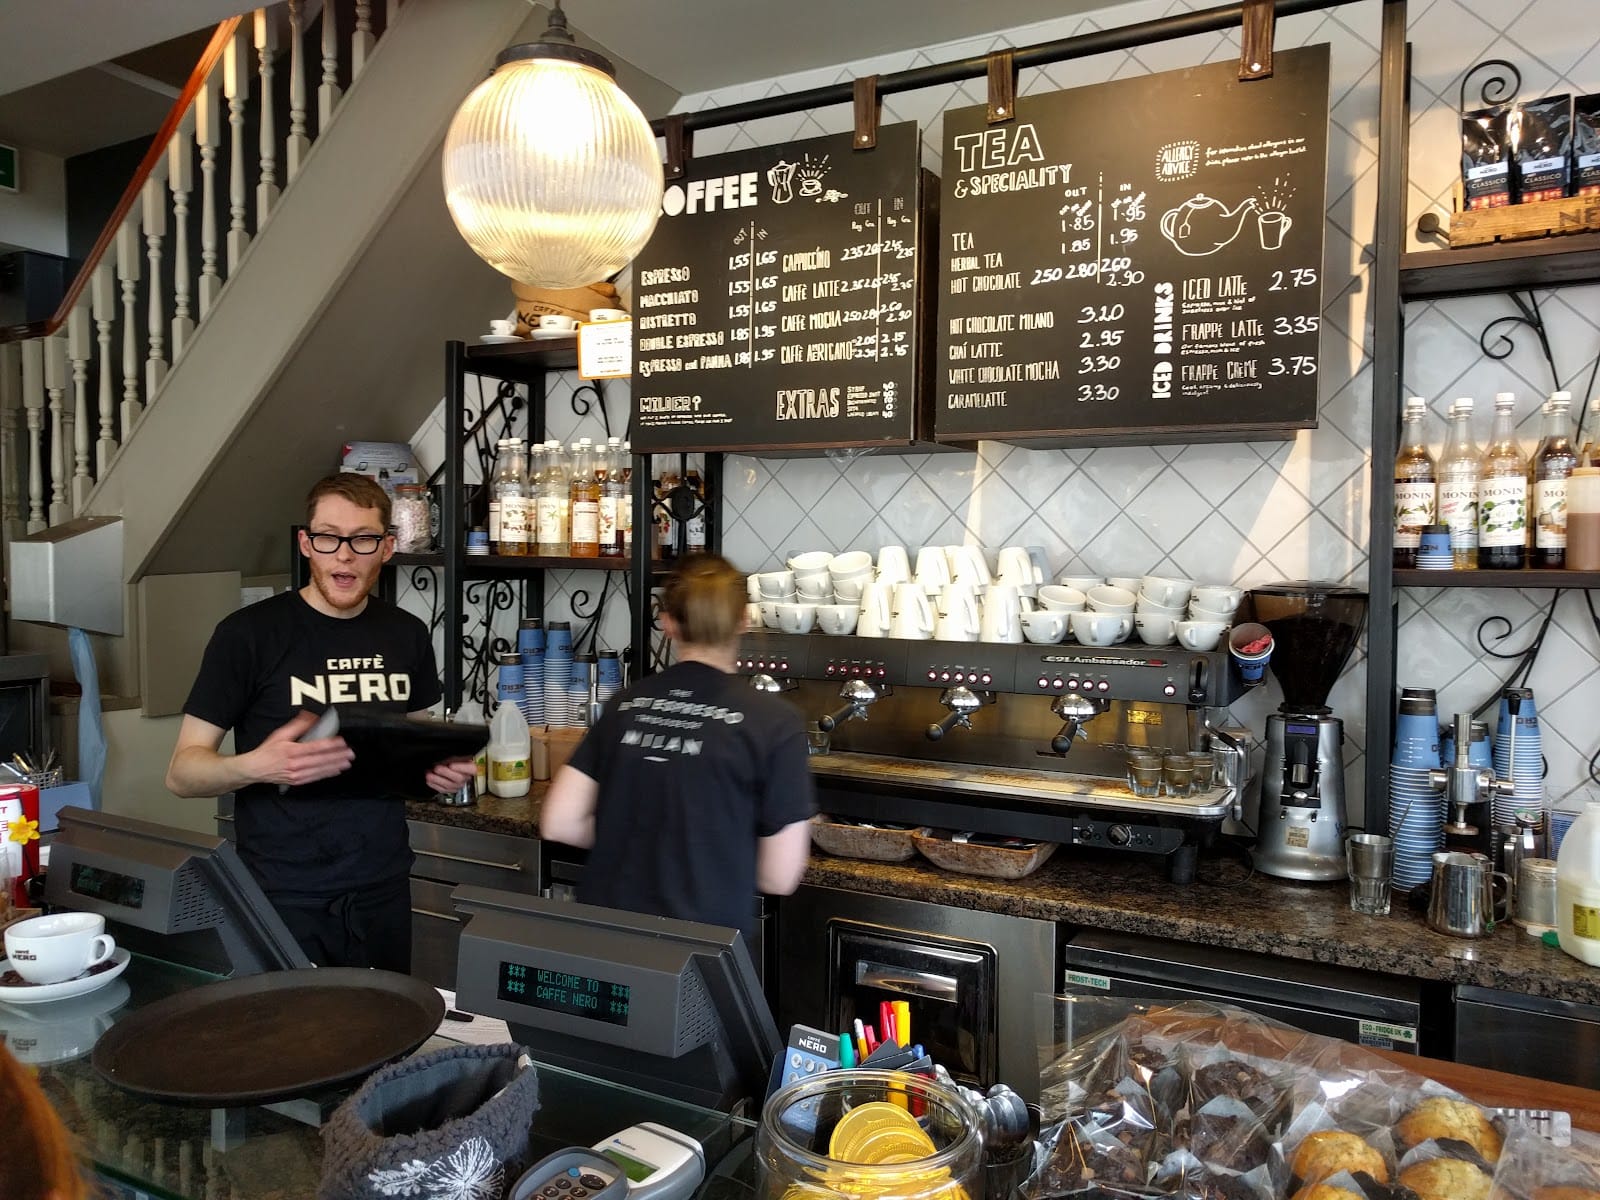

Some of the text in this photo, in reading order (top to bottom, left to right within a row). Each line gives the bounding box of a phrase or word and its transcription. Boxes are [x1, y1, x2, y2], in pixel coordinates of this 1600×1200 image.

[954, 123, 1045, 173] TEA
[954, 163, 1073, 199] & SPECIALITY
[1119, 183, 1132, 192] IN
[1471, 177, 1508, 189] CLASSICO
[1523, 172, 1562, 184] CLASSICO
[657, 171, 758, 217] OFFEE
[1064, 186, 1088, 198] OUT
[733, 227, 748, 245] OUT
[756, 228, 769, 240] IN
[951, 232, 974, 252] TEA
[983, 252, 1003, 269] TEA
[641, 266, 691, 287] ESPRESSO
[950, 272, 1021, 295] HOT CHOCOLATE
[1268, 268, 1317, 292] 2.75
[812, 279, 840, 299] LATTE
[1182, 275, 1248, 301] ICED LATTE
[639, 289, 699, 309] MACCHIATO
[639, 312, 697, 330] RISTRETTO
[809, 309, 842, 331] MOCHA
[949, 311, 1054, 335] HOT CHOCOLATE MILANO
[1231, 319, 1265, 338] LATTE
[1273, 316, 1320, 335] 3.35
[675, 330, 725, 349] ESPRESSO
[1079, 330, 1126, 349] 2.95
[1151, 282, 1175, 399] ICED DRINKS
[970, 342, 1003, 359] LATTE
[639, 358, 683, 378] ESPRESSO
[700, 353, 733, 370] PANNA
[949, 360, 1060, 385] WHITE CHOCOLATE MOCHA
[1078, 355, 1121, 375] 3.30
[1268, 356, 1317, 376] 3.75
[1077, 384, 1120, 402] 3.30
[776, 387, 841, 421] EXTRAS
[1483, 487, 1524, 497] MONIN
[326, 654, 385, 671] CAFFÈ
[1074, 656, 1146, 667] Ambassador
[290, 672, 412, 706] NERO
[537, 969, 599, 993] WELCOME TO
[1068, 973, 1108, 988] FROST-TECH
[536, 985, 598, 1009] CAFFE NERO
[798, 1037, 828, 1054] NERO
